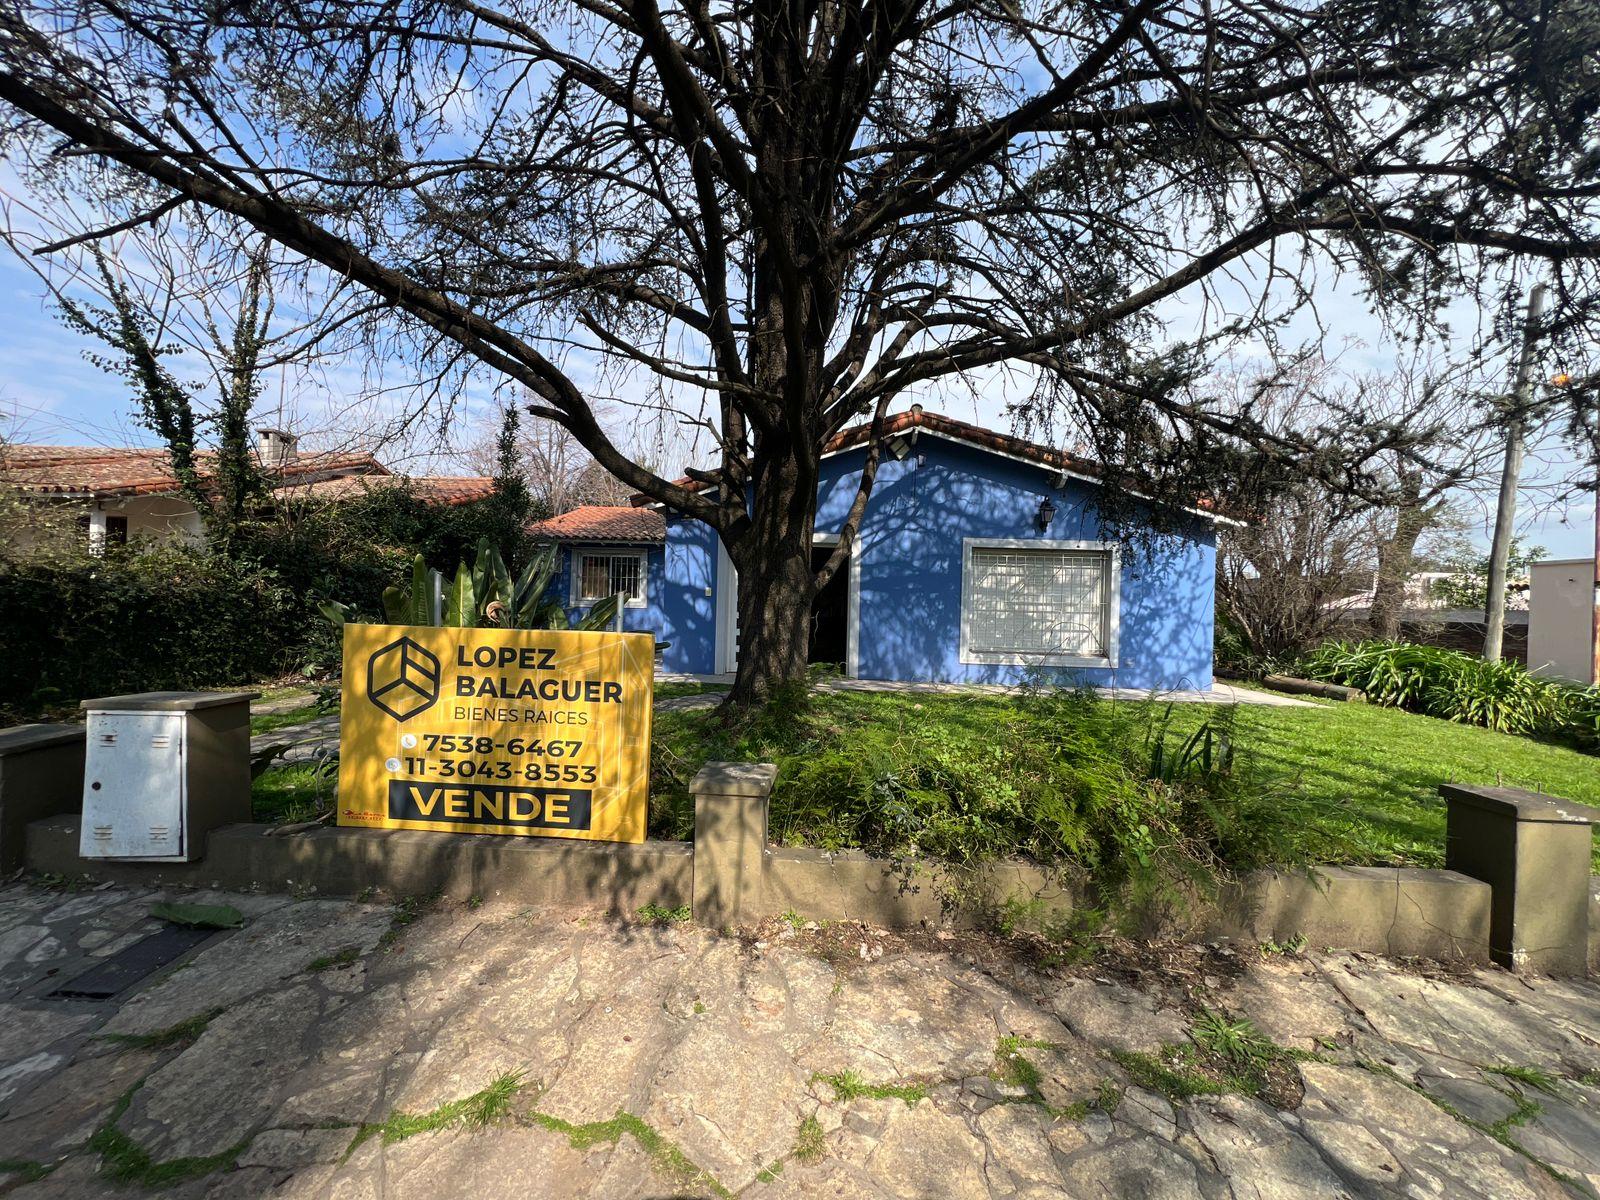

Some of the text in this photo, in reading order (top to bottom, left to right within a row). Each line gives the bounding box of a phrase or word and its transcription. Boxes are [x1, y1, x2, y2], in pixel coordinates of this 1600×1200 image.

[457, 645, 556, 671] LOPEZ
[456, 676, 623, 703] BALAGUER
[454, 706, 588, 725] BIENES RAICES
[423, 734, 583, 758] 7538-6467
[405, 756, 597, 783] 11-3043-8553
[409, 786, 571, 824] VENDE
